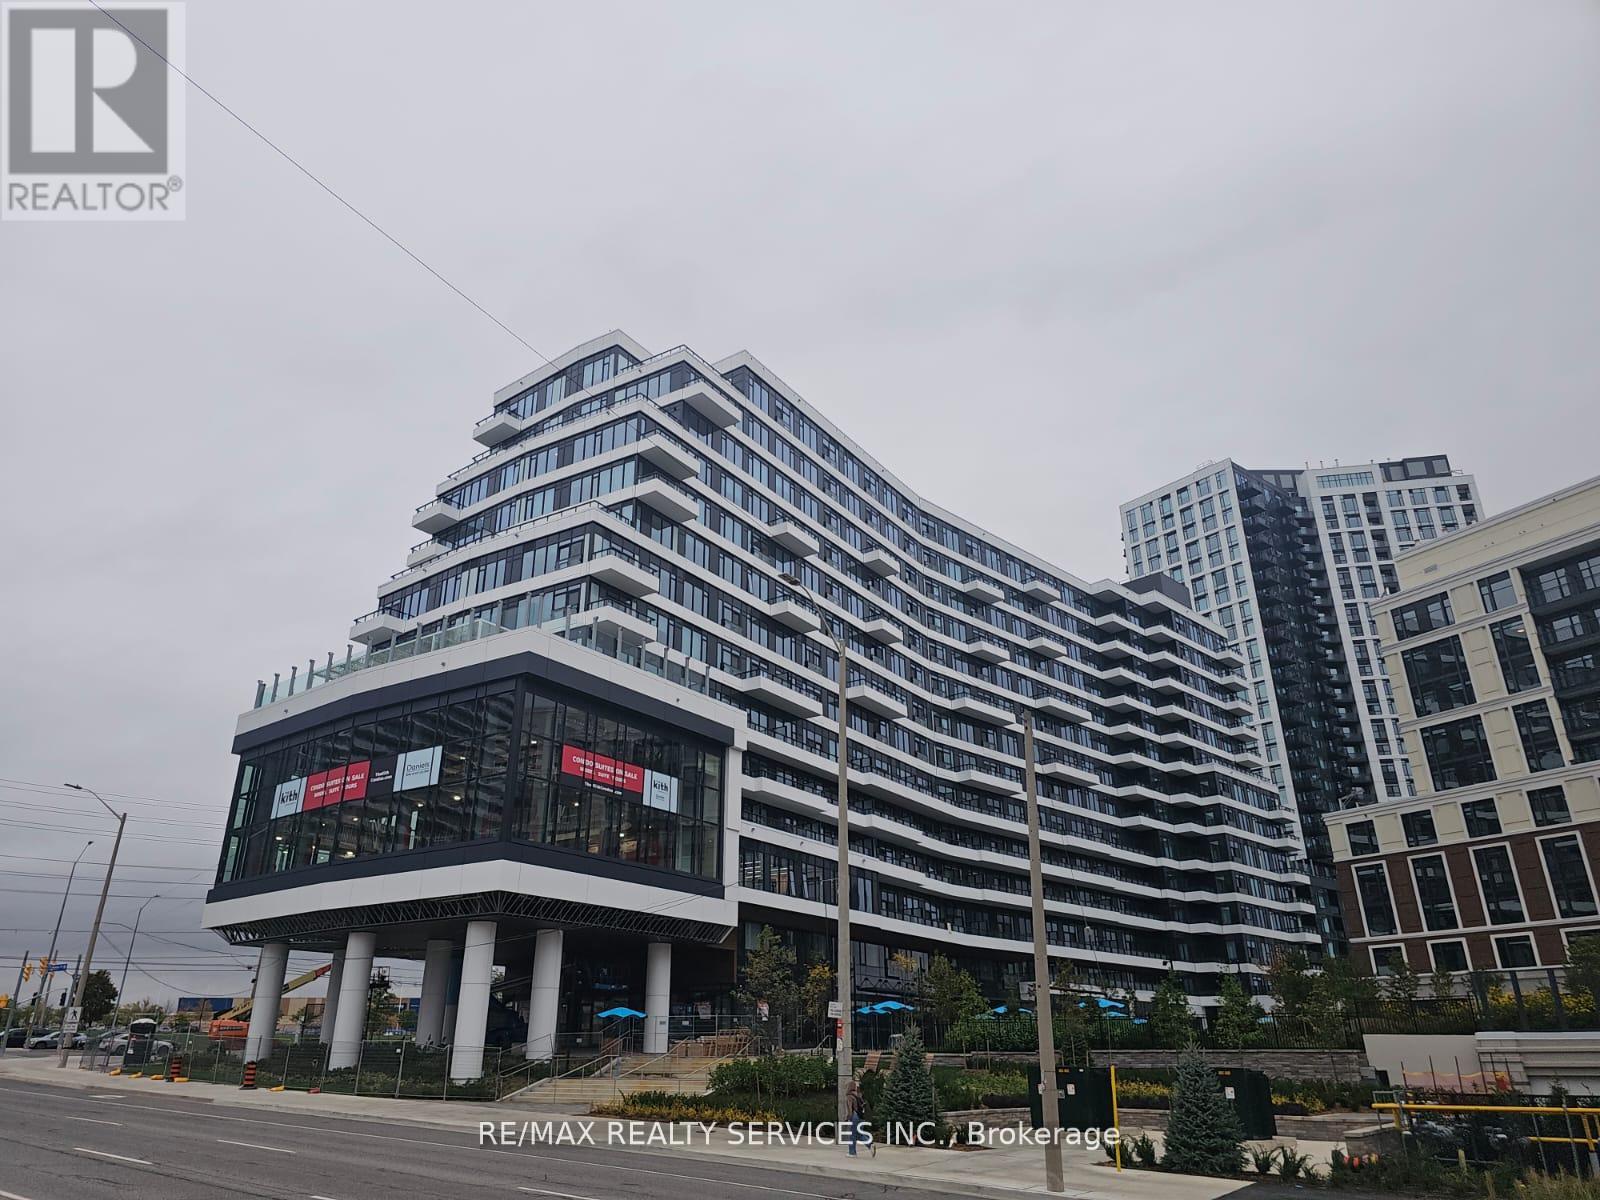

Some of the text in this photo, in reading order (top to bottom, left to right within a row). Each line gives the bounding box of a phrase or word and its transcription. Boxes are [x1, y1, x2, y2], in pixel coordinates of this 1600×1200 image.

[572, 756, 594, 767] CONDO
[594, 762, 615, 773] SUITES
[624, 770, 639, 780] SALE
[351, 773, 365, 781] SALE
[653, 780, 669, 792] kith
[280, 790, 299, 804] kith
